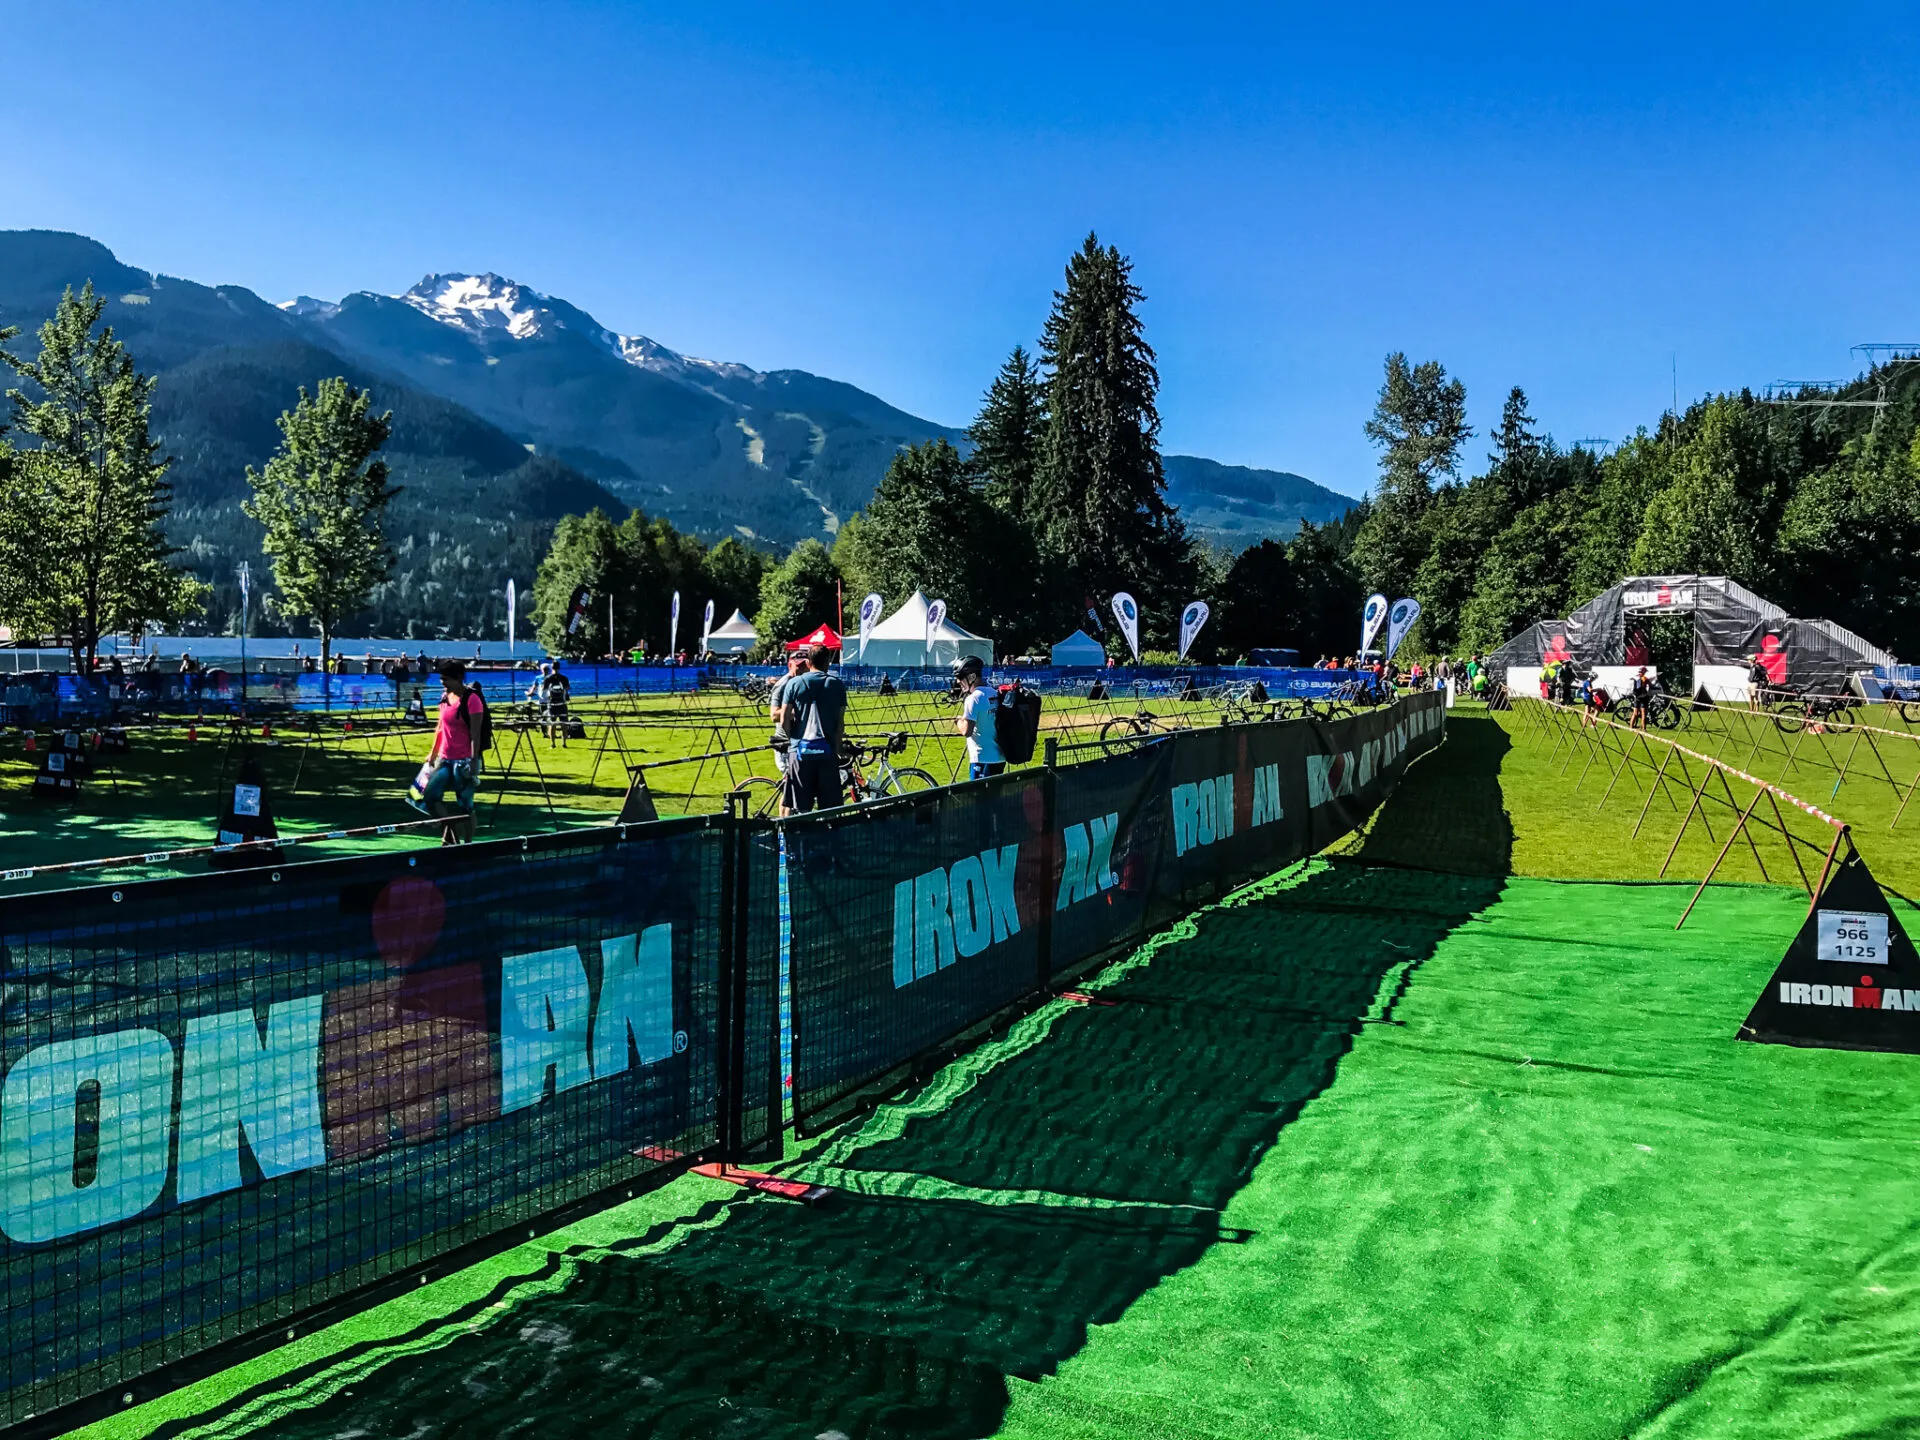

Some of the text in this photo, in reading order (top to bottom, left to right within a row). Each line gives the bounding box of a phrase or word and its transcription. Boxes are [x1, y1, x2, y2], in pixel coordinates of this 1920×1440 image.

[1624, 587, 1694, 606] IRONMAN
[1369, 603, 1386, 633] SUBARU
[1399, 605, 1420, 633] SUBARU
[1836, 928, 1869, 941] 966
[1834, 945, 1876, 958] 1125
[1779, 977, 1920, 1011] IRONMAN
